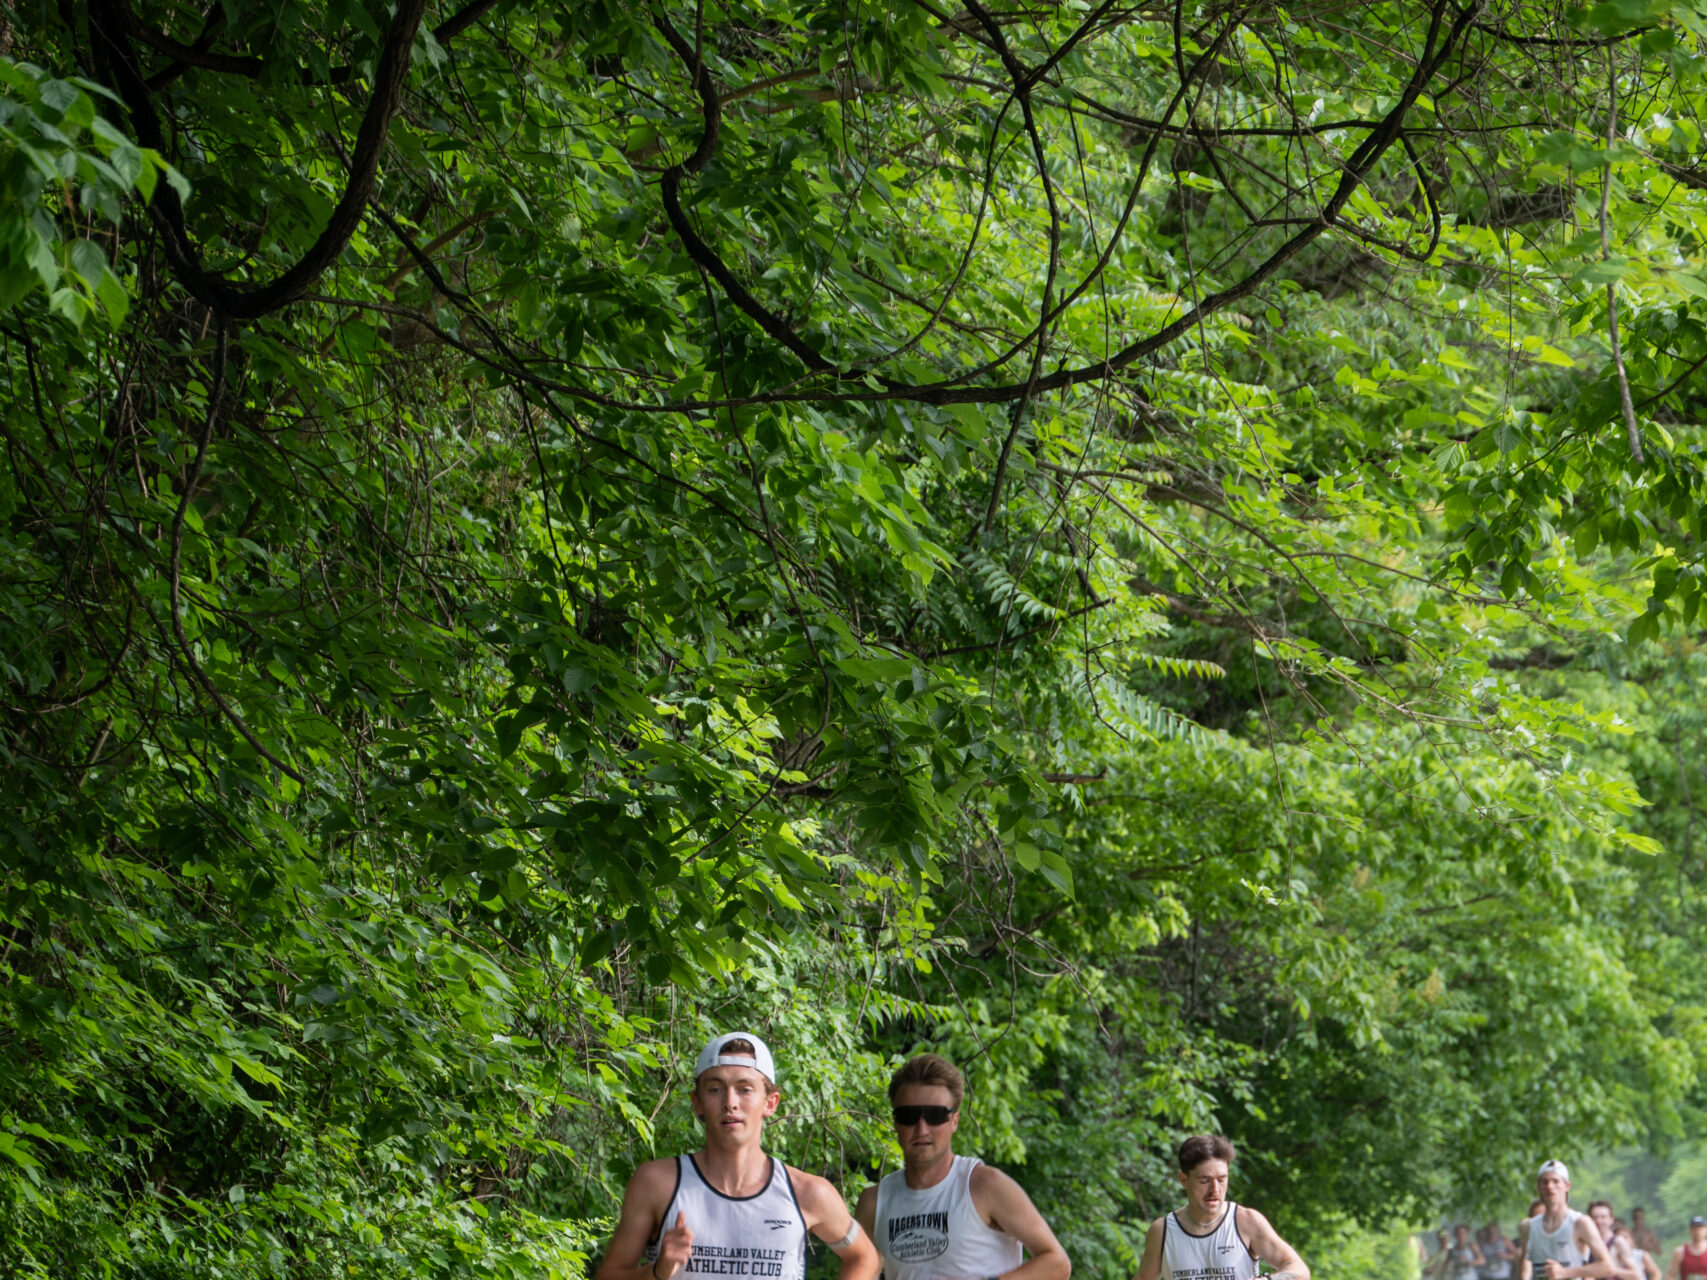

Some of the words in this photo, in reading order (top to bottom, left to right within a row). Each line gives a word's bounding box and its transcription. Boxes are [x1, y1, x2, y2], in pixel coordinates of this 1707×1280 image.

[889, 1211, 948, 1242] HAGERSTOWN
[690, 1245, 749, 1259] UMBERLAND
[750, 1248, 786, 1260] VALLEY
[685, 1258, 750, 1275] ATHLETIC
[751, 1261, 783, 1277] CLUB
[1213, 1267, 1235, 1275] VALLEY
